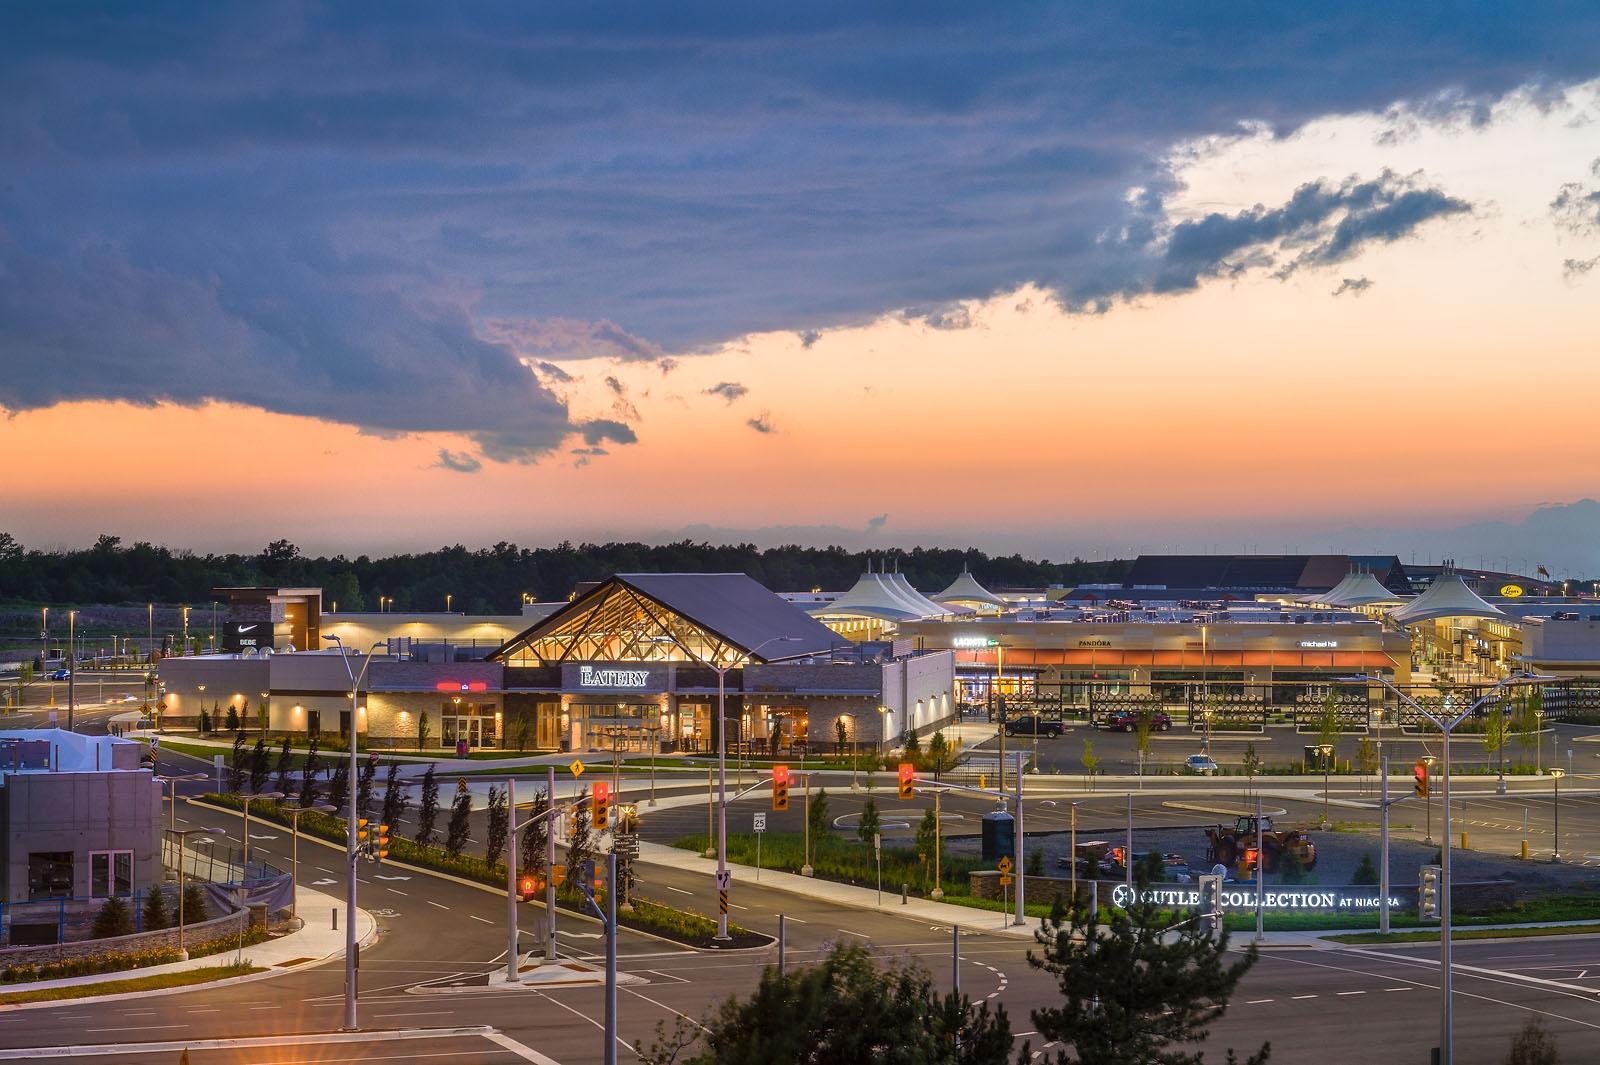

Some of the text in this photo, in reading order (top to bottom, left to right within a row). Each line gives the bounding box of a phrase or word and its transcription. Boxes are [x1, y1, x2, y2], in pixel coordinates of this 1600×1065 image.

[953, 637, 988, 647] LACOSTE
[580, 670, 649, 687] EATERY
[755, 819, 765, 828] 25
[1140, 890, 1200, 905] OUTLE
[1339, 898, 1353, 907] AT
[1355, 898, 1399, 907] NIAGRA
